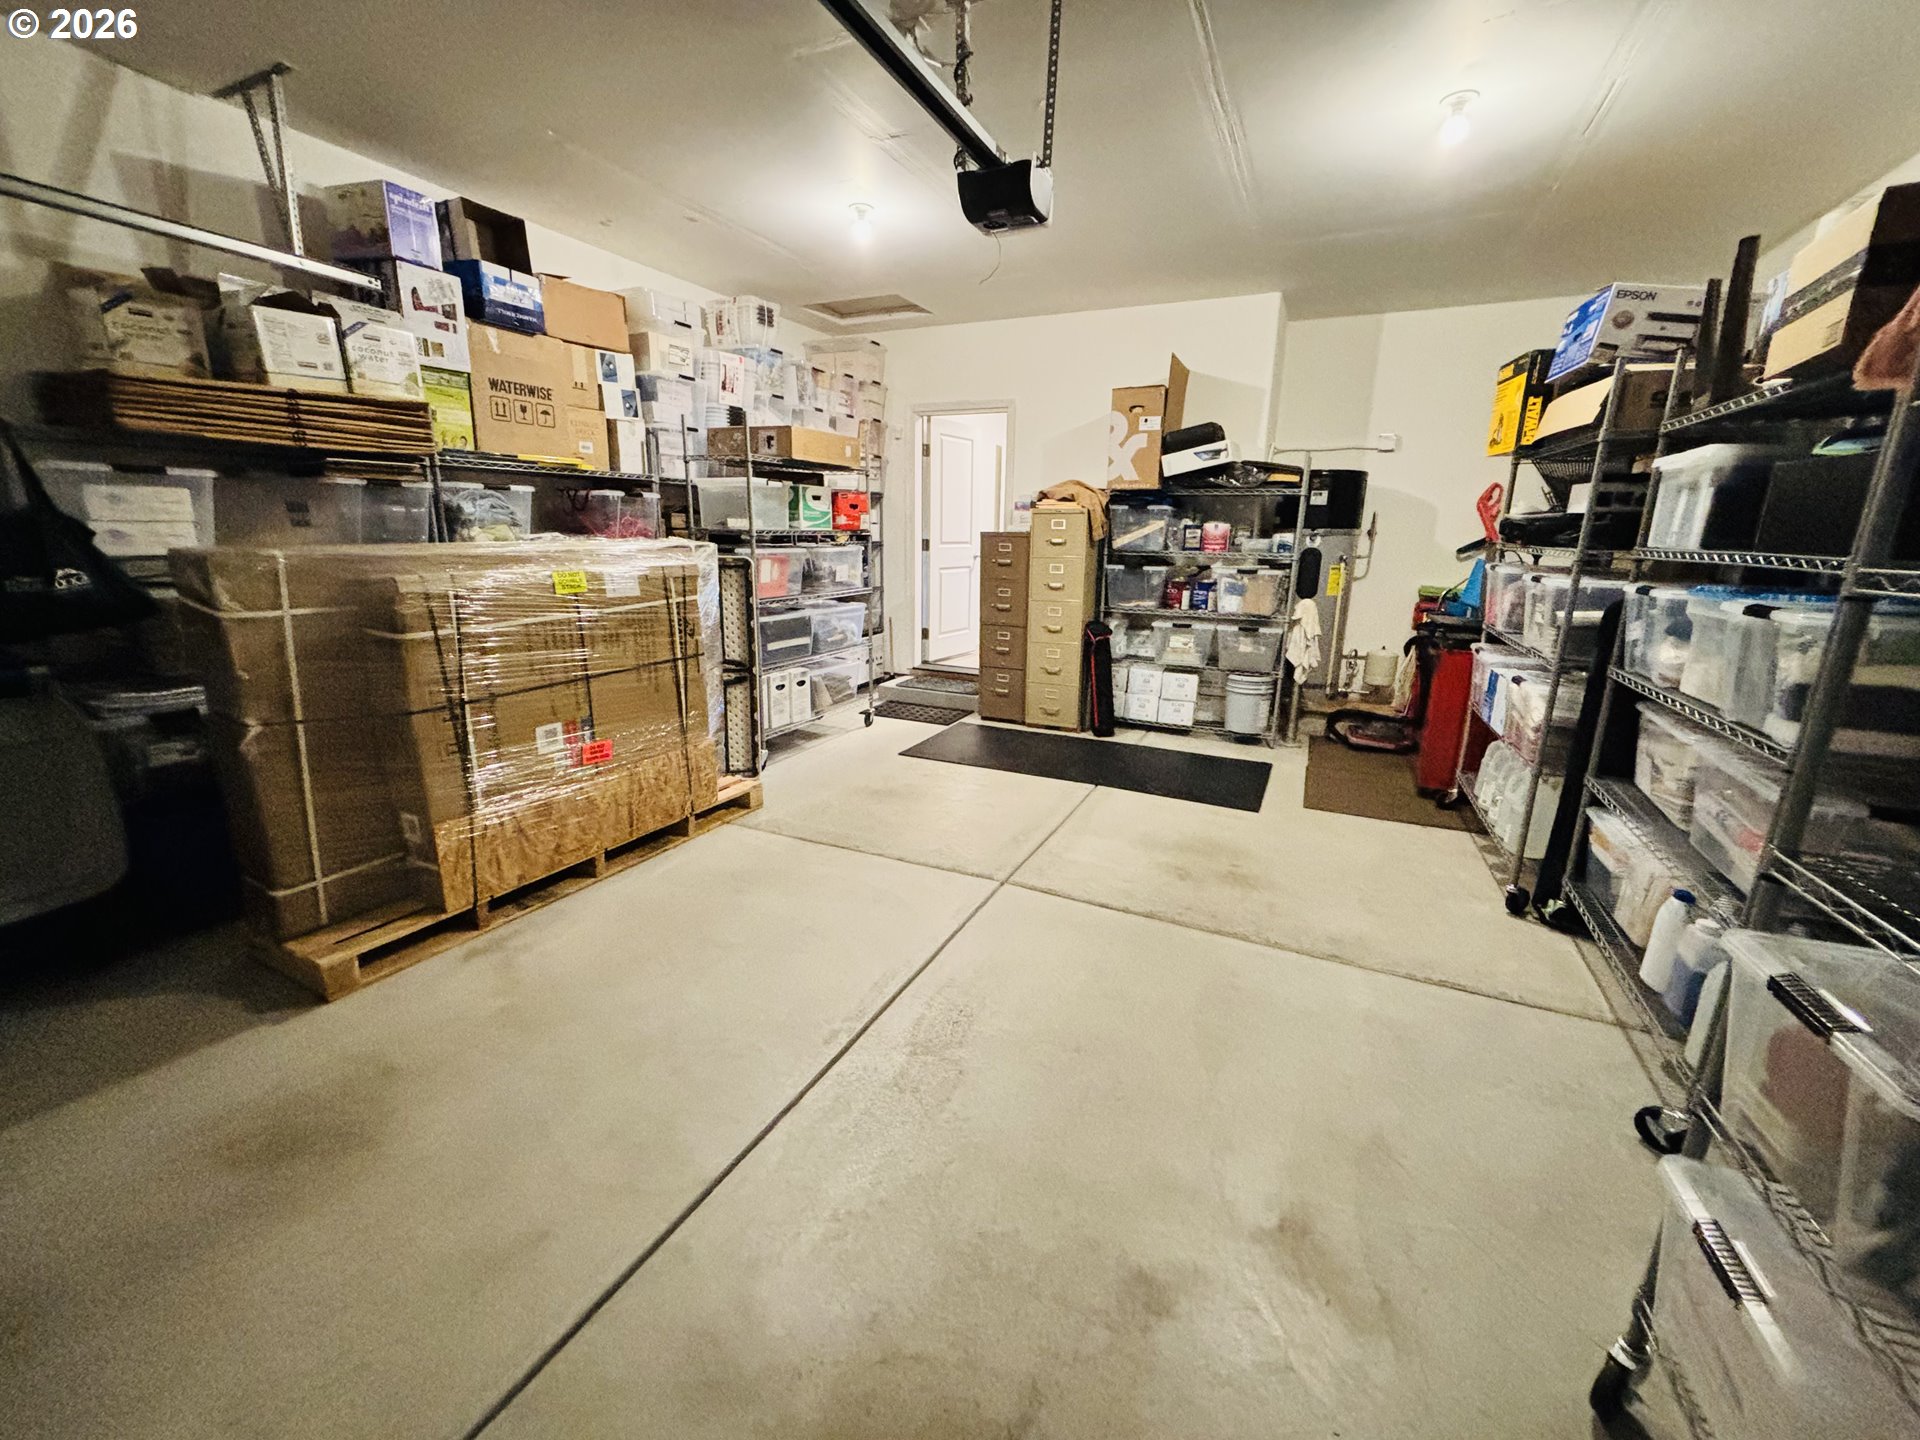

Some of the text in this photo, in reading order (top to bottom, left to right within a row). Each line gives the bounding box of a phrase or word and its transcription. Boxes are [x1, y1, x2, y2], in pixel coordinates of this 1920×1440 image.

[1616, 289, 1658, 301] EPSON
[351, 345, 395, 358] coconut
[487, 376, 553, 401] WATERWISE
